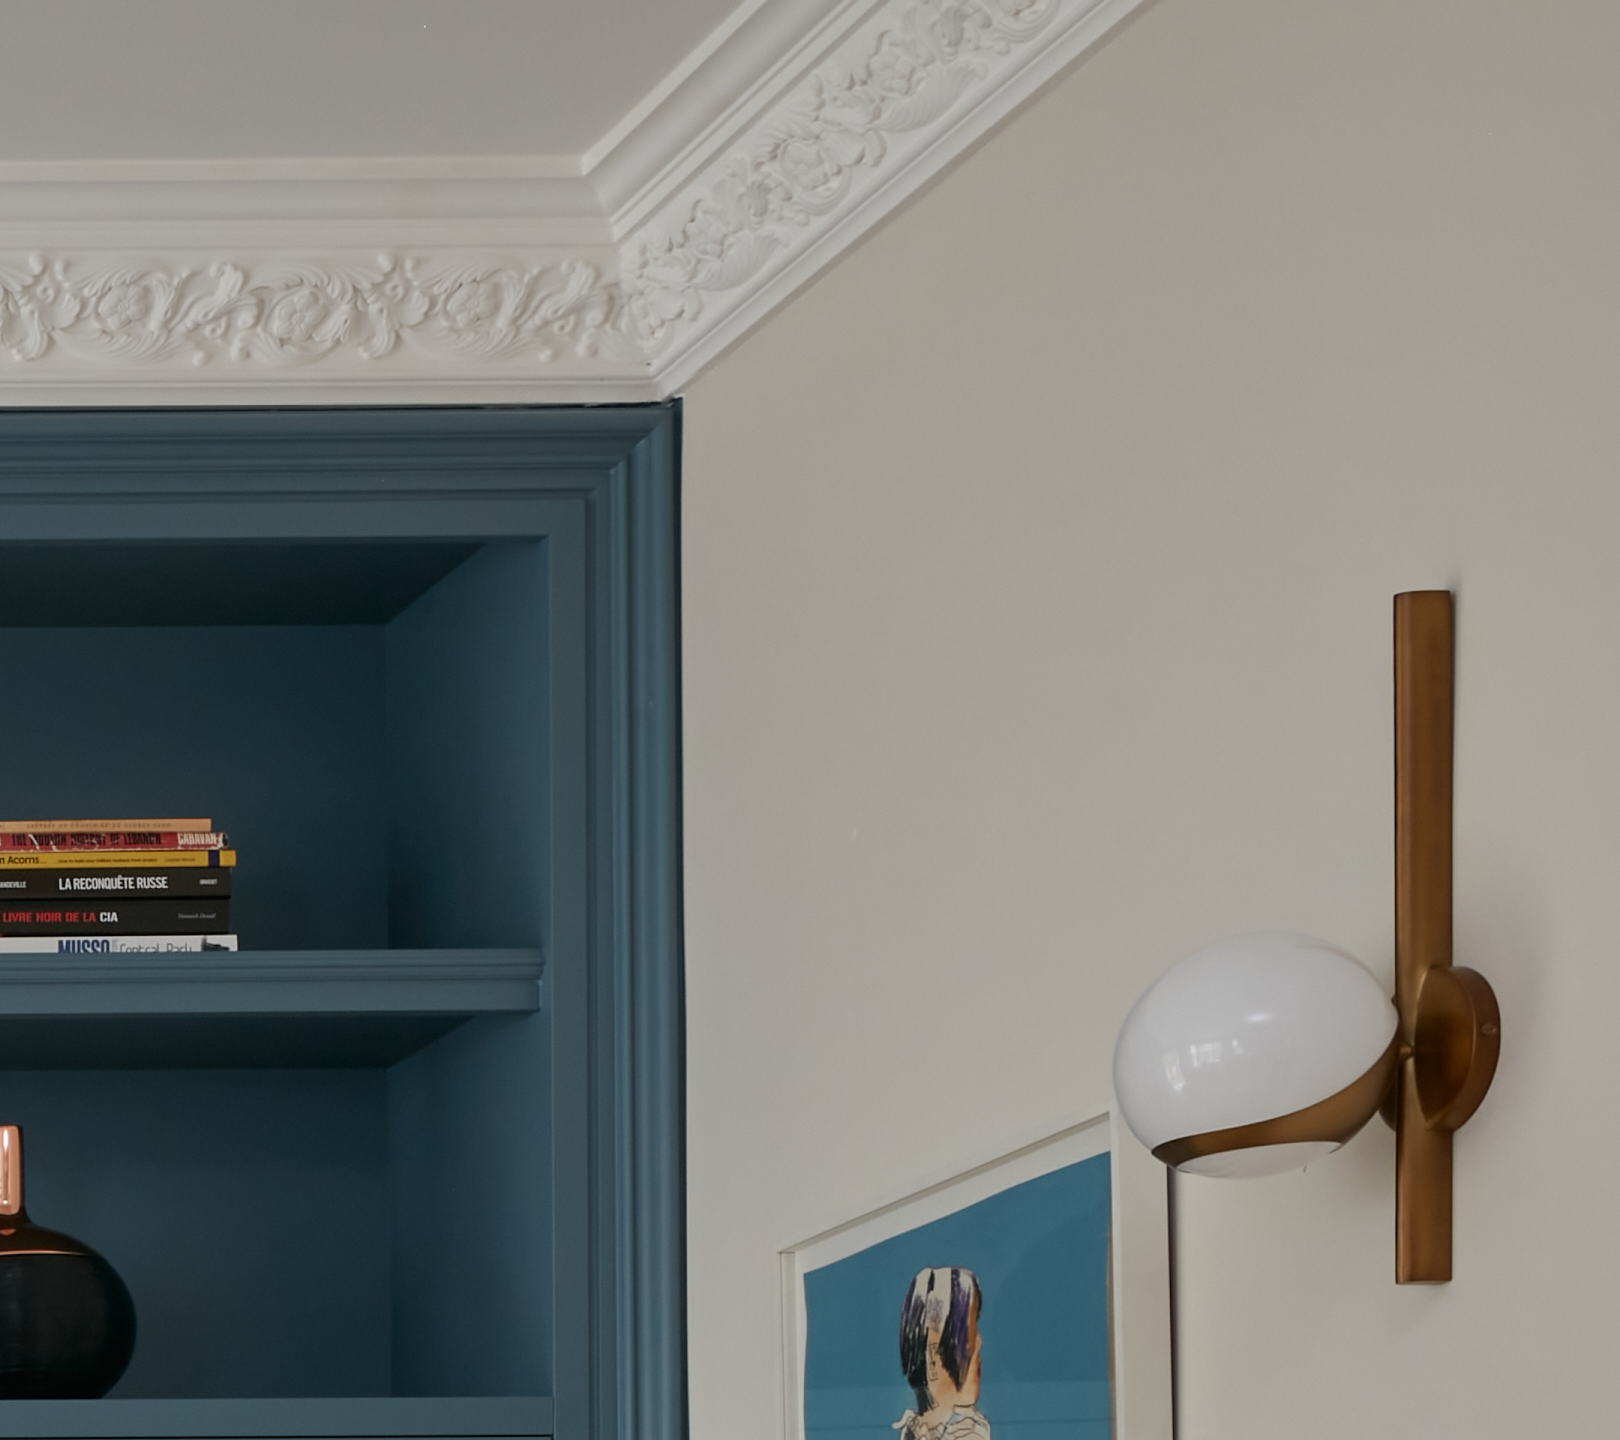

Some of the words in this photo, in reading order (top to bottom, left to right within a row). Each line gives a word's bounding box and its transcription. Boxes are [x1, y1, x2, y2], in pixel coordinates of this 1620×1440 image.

[59, 878, 71, 890] LA
[73, 875, 134, 890] RECONQUÊTE
[137, 877, 168, 888] RUSSE
[3, 912, 32, 922] LIVRE
[36, 912, 62, 922] NOIR
[65, 912, 79, 922] DE
[83, 912, 96, 922] LA
[100, 912, 118, 922] CIA
